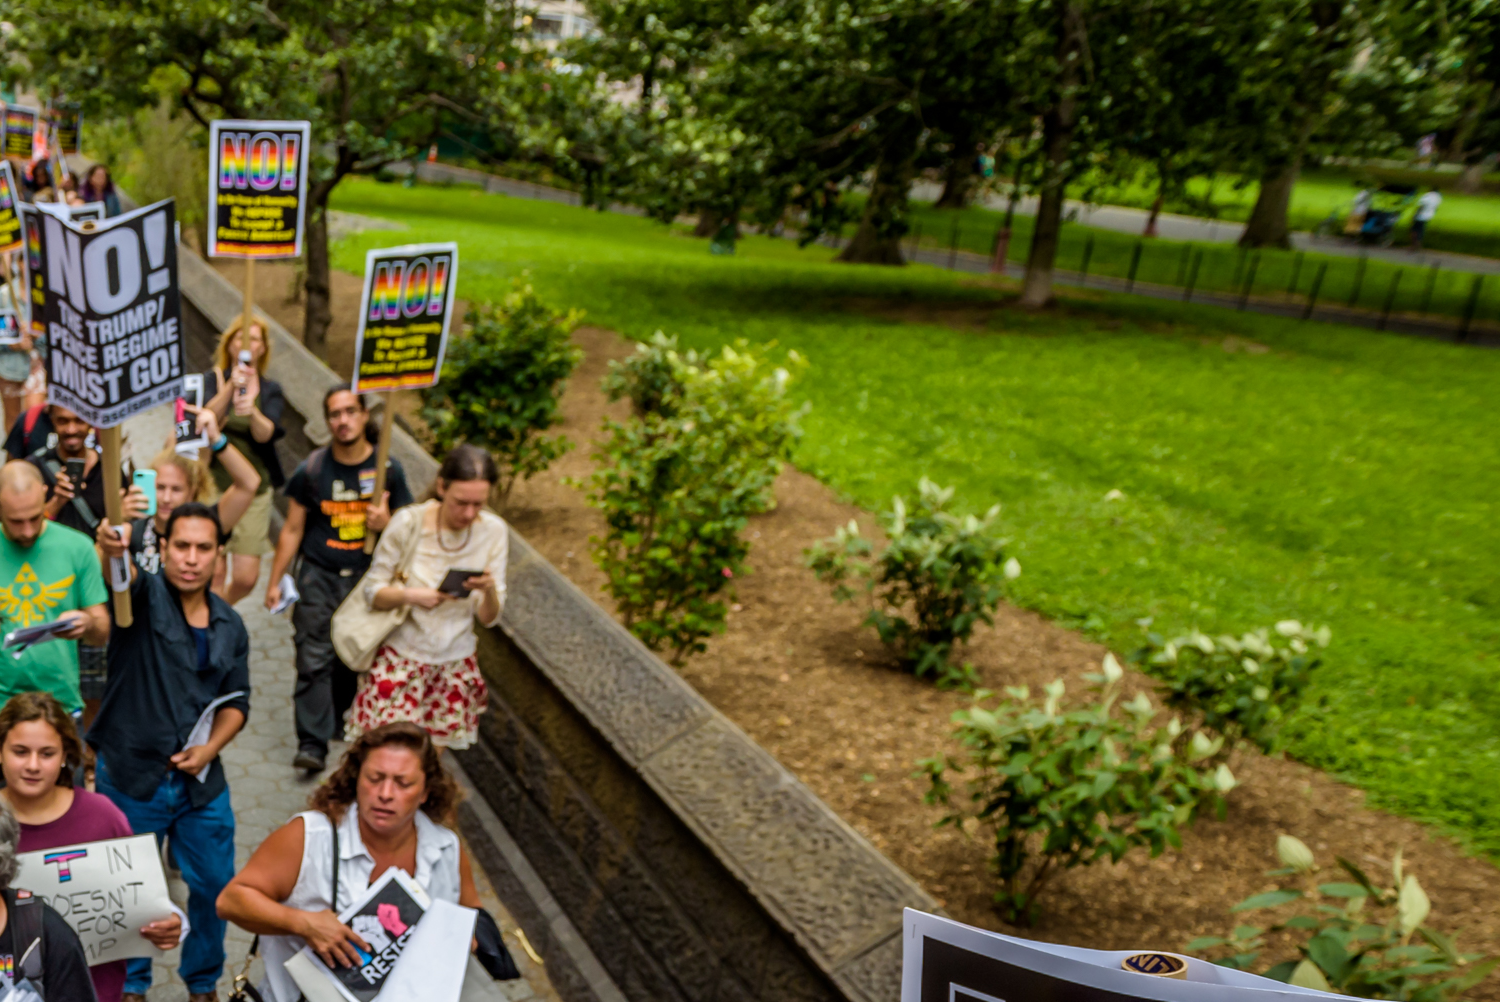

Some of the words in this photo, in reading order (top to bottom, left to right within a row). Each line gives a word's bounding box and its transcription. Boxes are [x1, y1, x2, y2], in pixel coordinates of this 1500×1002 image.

[219, 131, 300, 191] NO!
[44, 209, 171, 315] NO!
[368, 255, 450, 322] NO!
[49, 321, 100, 371] PENCE
[102, 316, 179, 370] REGIME
[57, 299, 85, 341] THE
[85, 294, 166, 347] TRUMP/
[51, 349, 123, 406] MUST
[129, 342, 181, 395] GO!
[44, 849, 87, 883] T
[106, 845, 132, 875] IN
[46, 881, 144, 917] OESN'T
[77, 911, 127, 937] FOR
